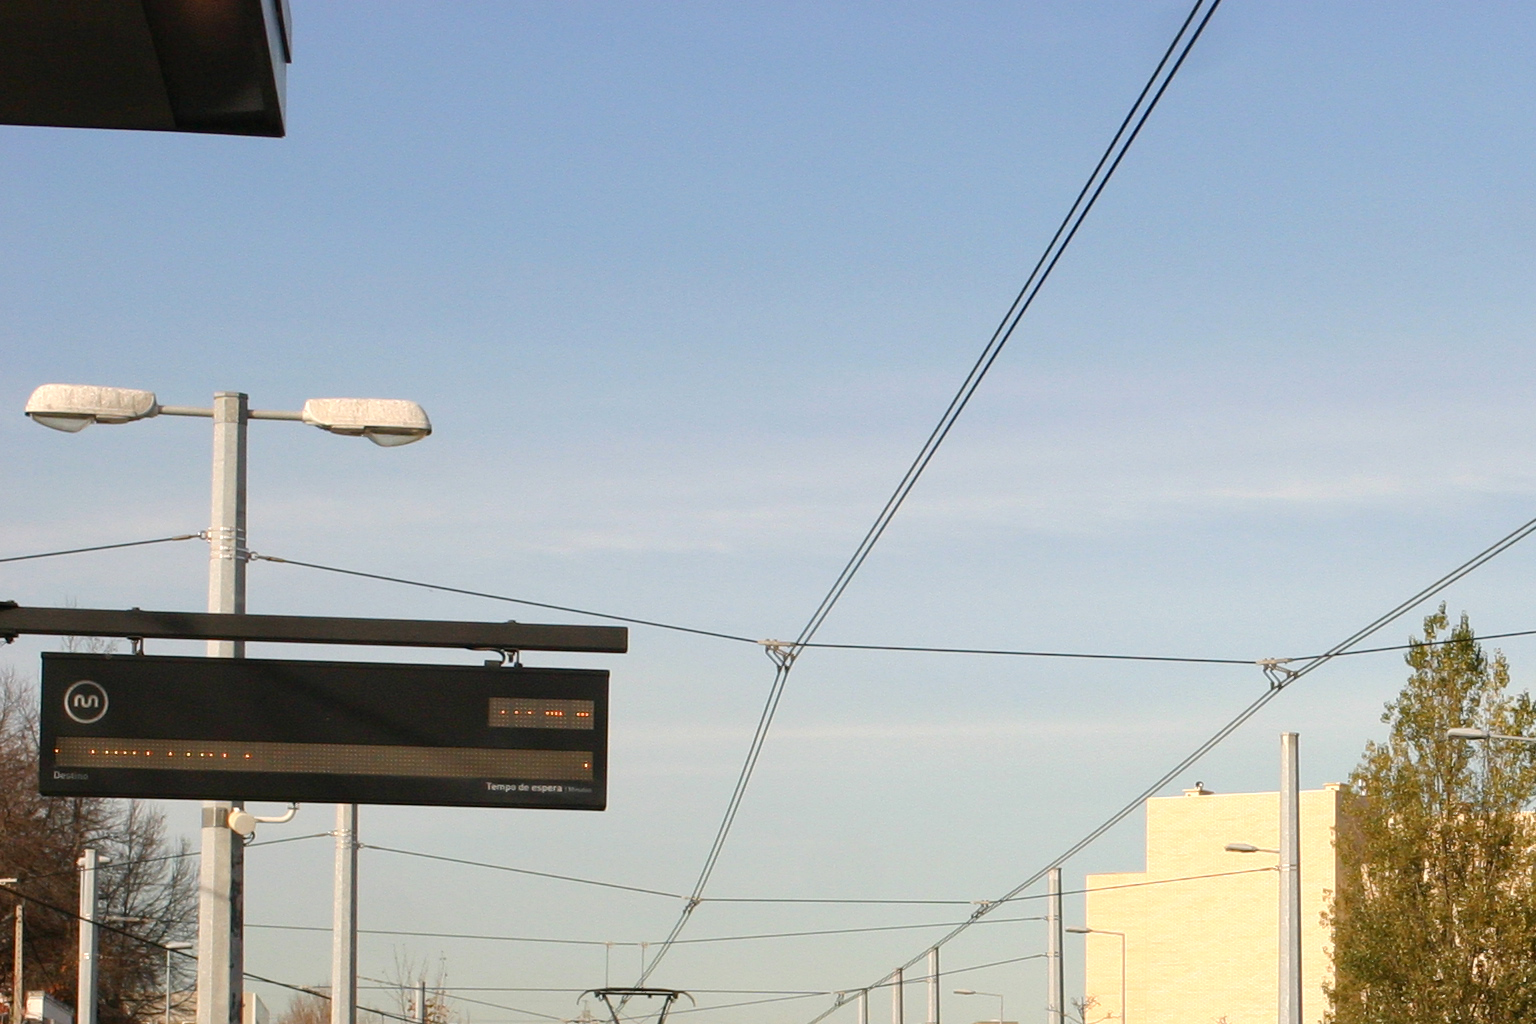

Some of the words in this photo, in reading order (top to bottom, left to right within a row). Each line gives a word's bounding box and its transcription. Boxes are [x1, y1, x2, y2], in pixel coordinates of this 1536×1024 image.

[486, 781, 517, 793] Tempo
[518, 782, 530, 792] de
[531, 783, 563, 794] espera
